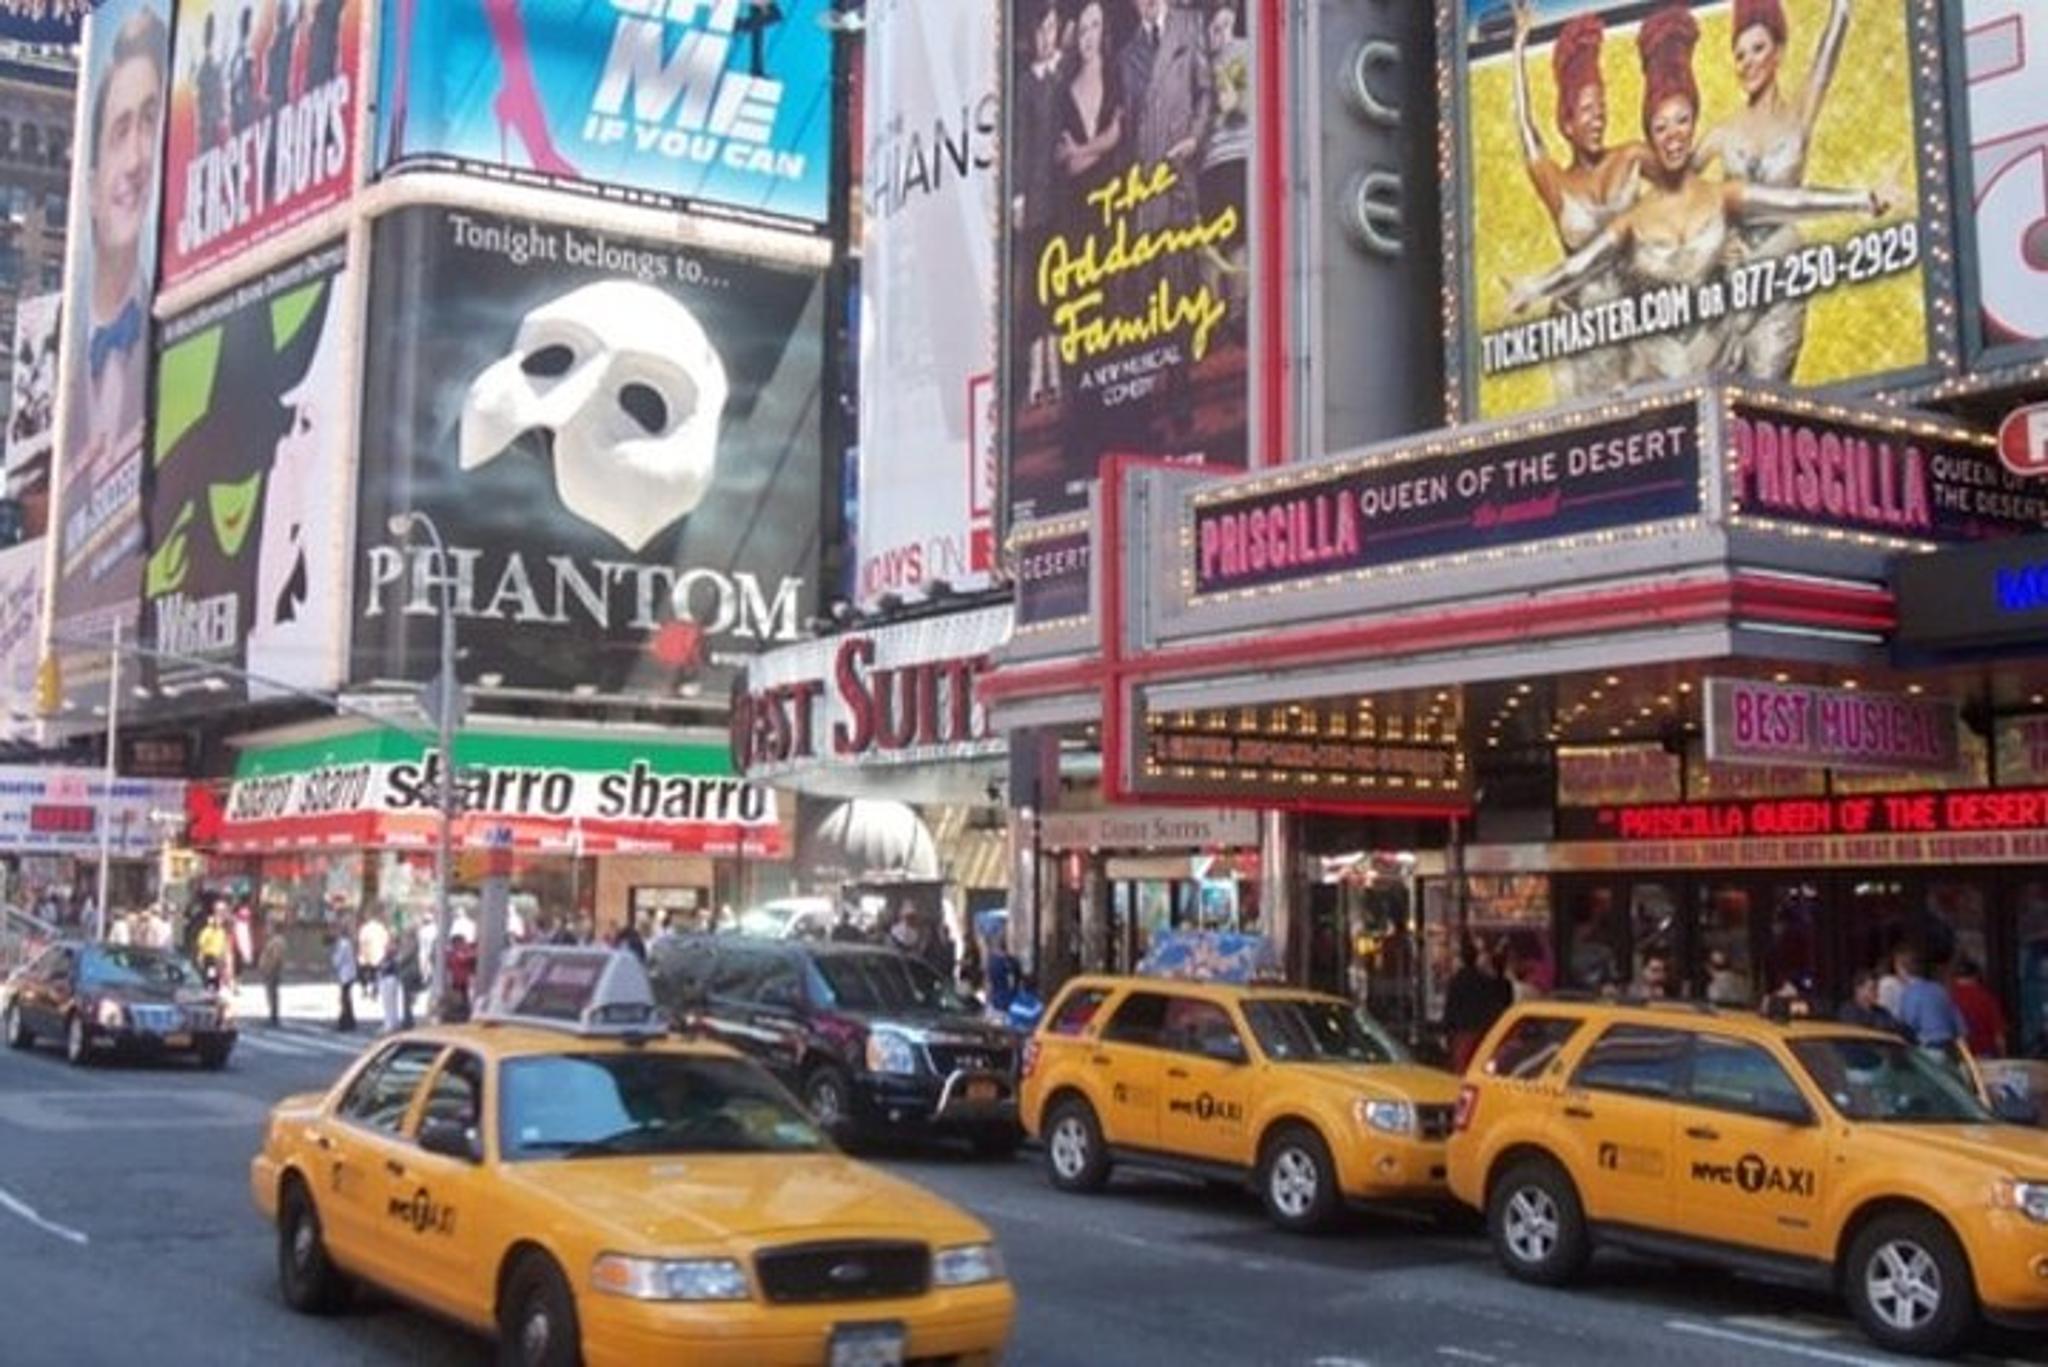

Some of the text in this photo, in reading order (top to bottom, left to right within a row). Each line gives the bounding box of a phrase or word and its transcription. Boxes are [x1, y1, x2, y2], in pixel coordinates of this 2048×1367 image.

[591, 15, 784, 145] ME
[177, 113, 273, 256] JERSEY
[273, 74, 350, 205] BOYS
[582, 112, 807, 182] IF YOU CAN
[1087, 161, 1178, 228] The
[448, 212, 557, 265] Tonight
[564, 230, 669, 280] belongs
[1038, 204, 1238, 306] Addams
[1053, 277, 1226, 366] Family
[1481, 284, 1690, 371] TICKETMASTER.COM
[1729, 222, 1919, 308] 877-250-2929
[1200, 488, 1361, 580] PRISCILLA
[1360, 473, 1448, 516] QUEEN
[1456, 466, 1496, 497] OF
[1503, 452, 1559, 488] THE
[1567, 426, 1687, 476] DESERT
[1732, 414, 1931, 528] PRISCILLA
[1931, 453, 1999, 487] QUEEN
[1933, 483, 1972, 512] THE
[364, 545, 804, 642] PHANTOM
[1023, 546, 1089, 580] DESERT
[1734, 689, 1942, 755] BEST MUSICAL
[384, 750, 575, 816] sbarro
[597, 760, 765, 822] sbarro
[1751, 801, 1831, 834] QUEEN
[1840, 799, 1873, 831] OF
[1887, 796, 1937, 829] THE
[1690, 1151, 1816, 1198] NYC TAXI
